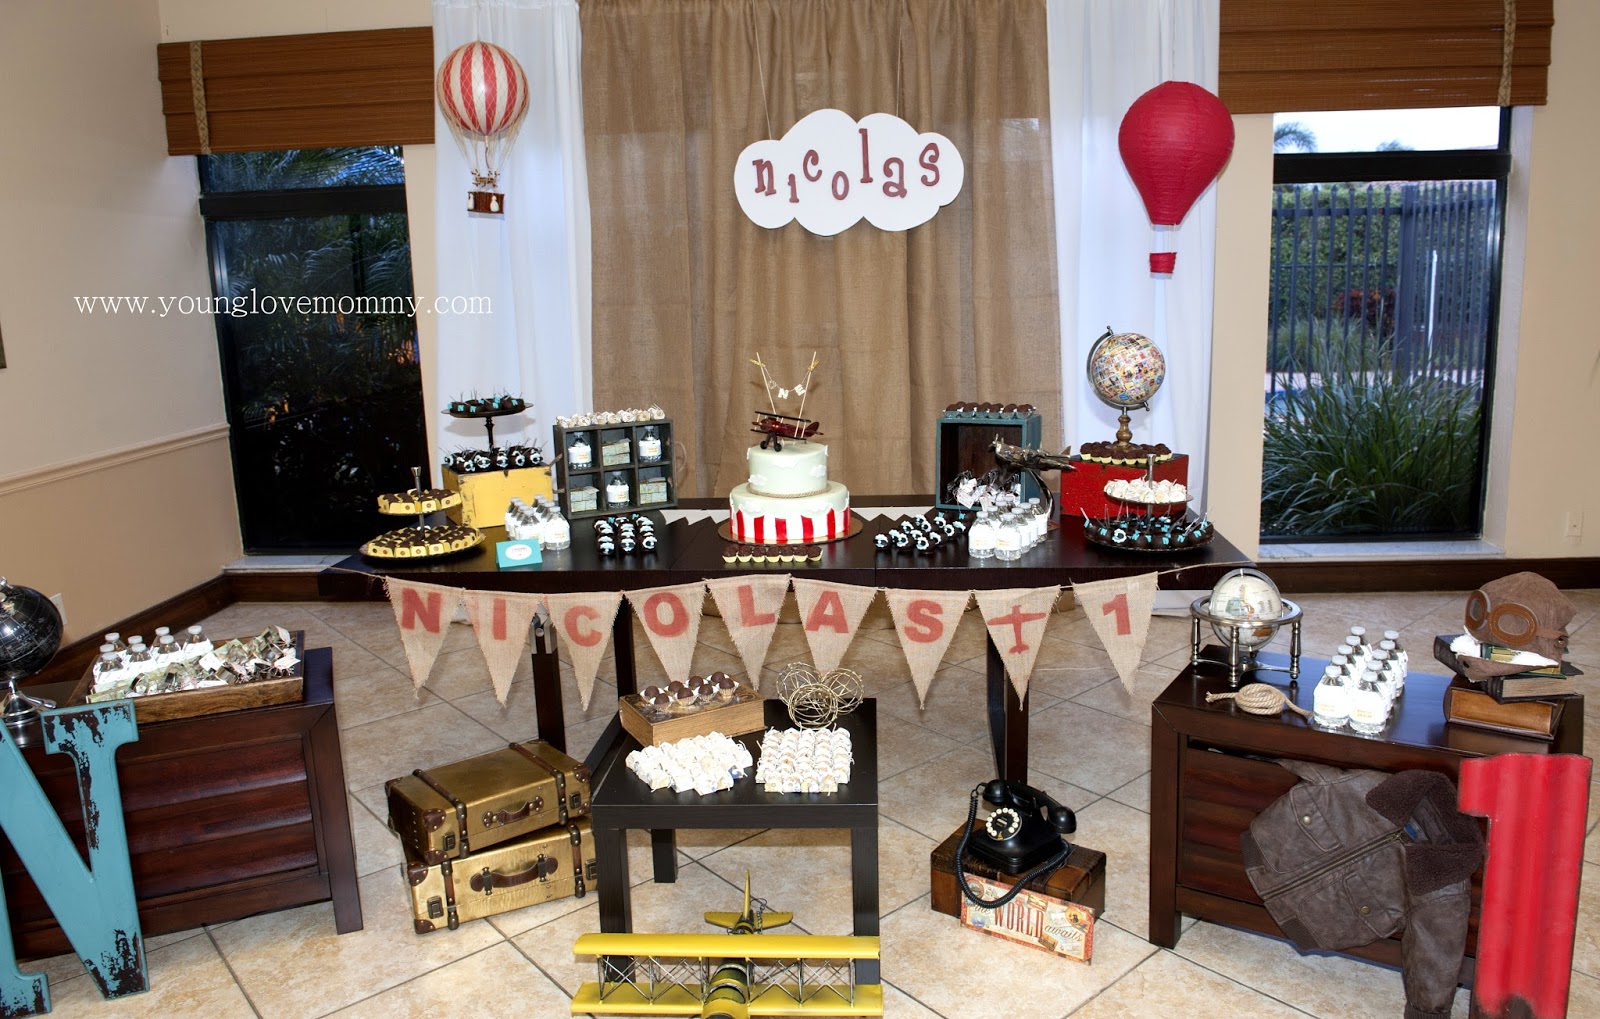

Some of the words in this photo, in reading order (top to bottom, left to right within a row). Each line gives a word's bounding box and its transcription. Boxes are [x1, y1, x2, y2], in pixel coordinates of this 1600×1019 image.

[752, 127, 941, 204] nicolas
[1102, 593, 1132, 636] 1
[994, 897, 1044, 938] WORLD
[1044, 924, 1083, 942] awaits
